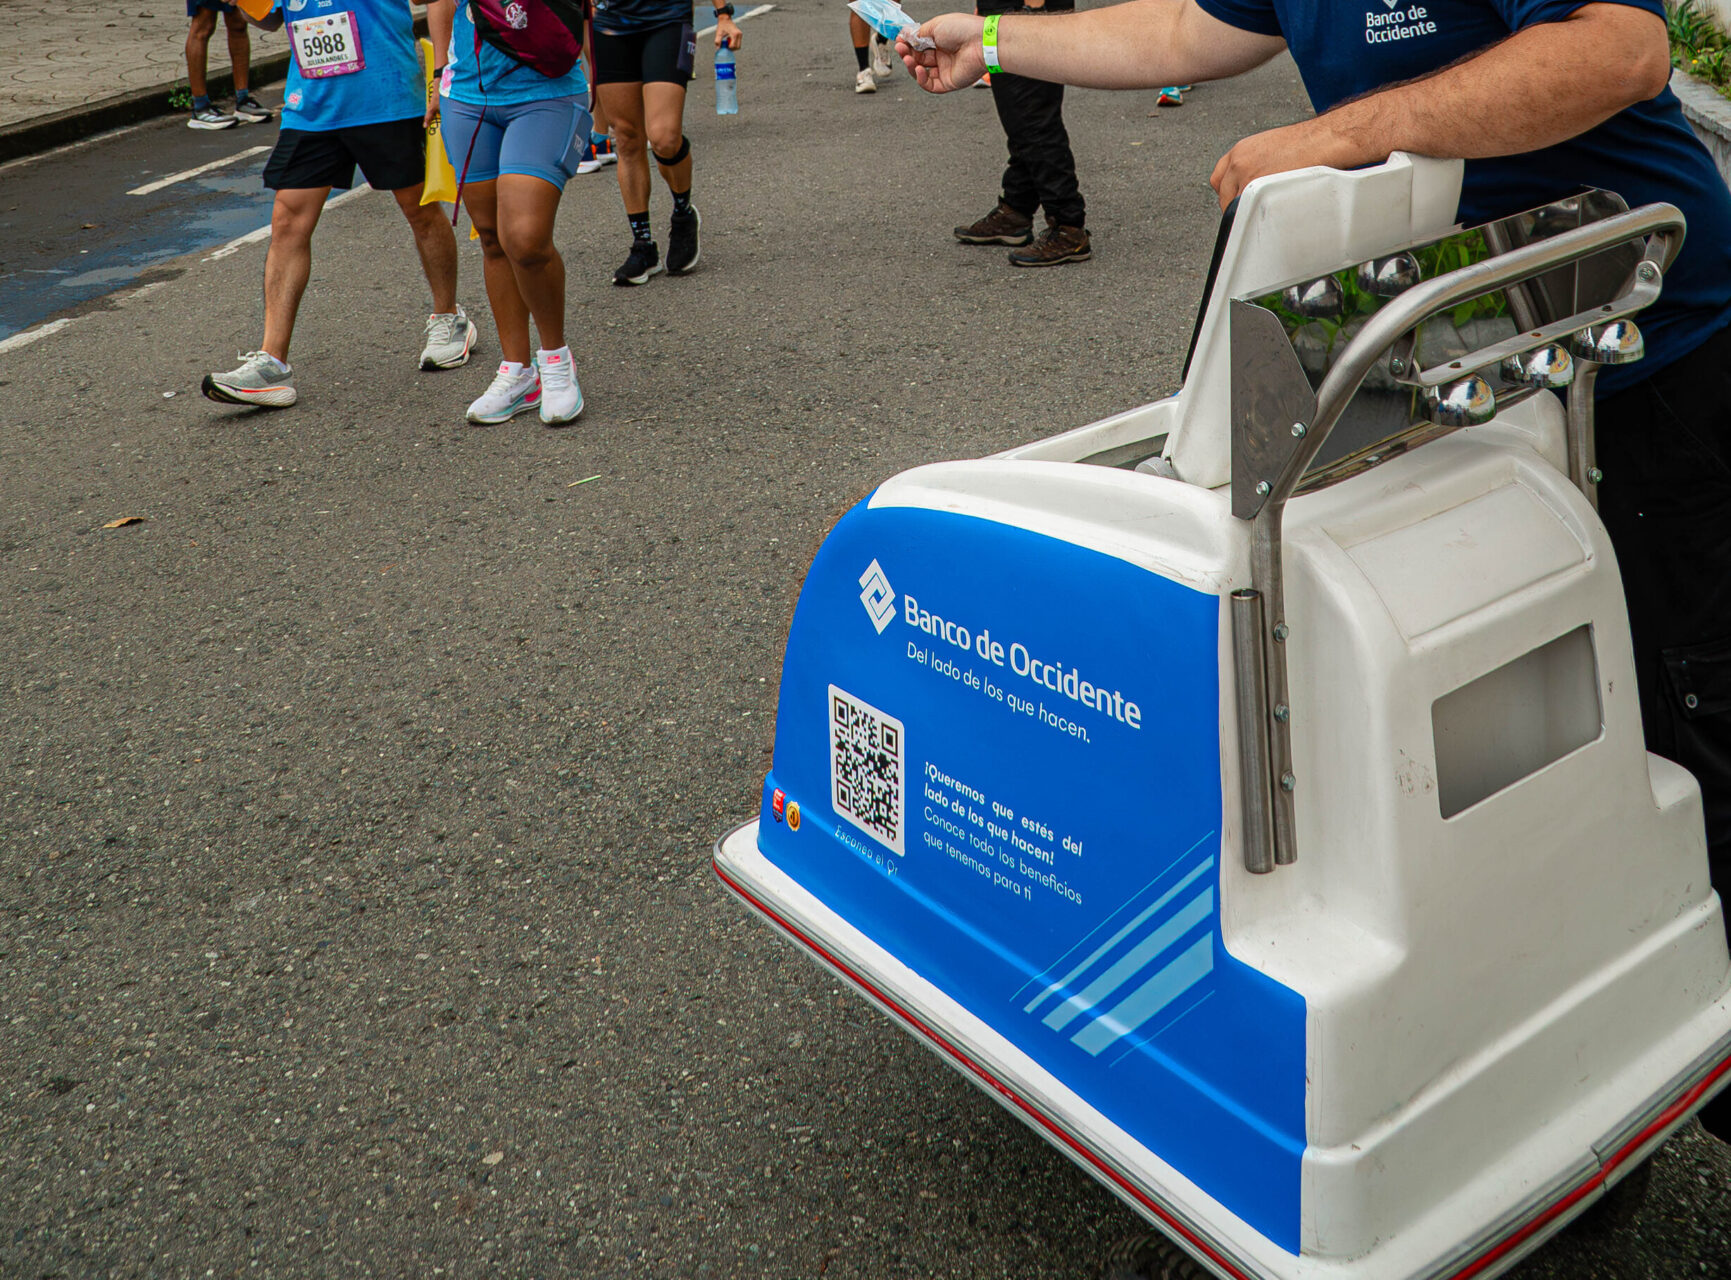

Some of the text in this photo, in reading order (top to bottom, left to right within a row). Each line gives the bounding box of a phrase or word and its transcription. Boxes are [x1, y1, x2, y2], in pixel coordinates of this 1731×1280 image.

[303, 33, 346, 58] 5988
[1366, 4, 1428, 28] Banco de
[1366, 21, 1438, 44] Occidente
[904, 593, 1142, 730] Banco de Occidente
[907, 641, 1091, 744] Del lado de los que hacen.
[924, 761, 1083, 857] ¡Queremos que estés del
[924, 782, 1055, 866] lado de los que hacen!
[923, 831, 1032, 902] que tenemos para ti
[924, 806, 1083, 905] Conoce todo los beneficios
